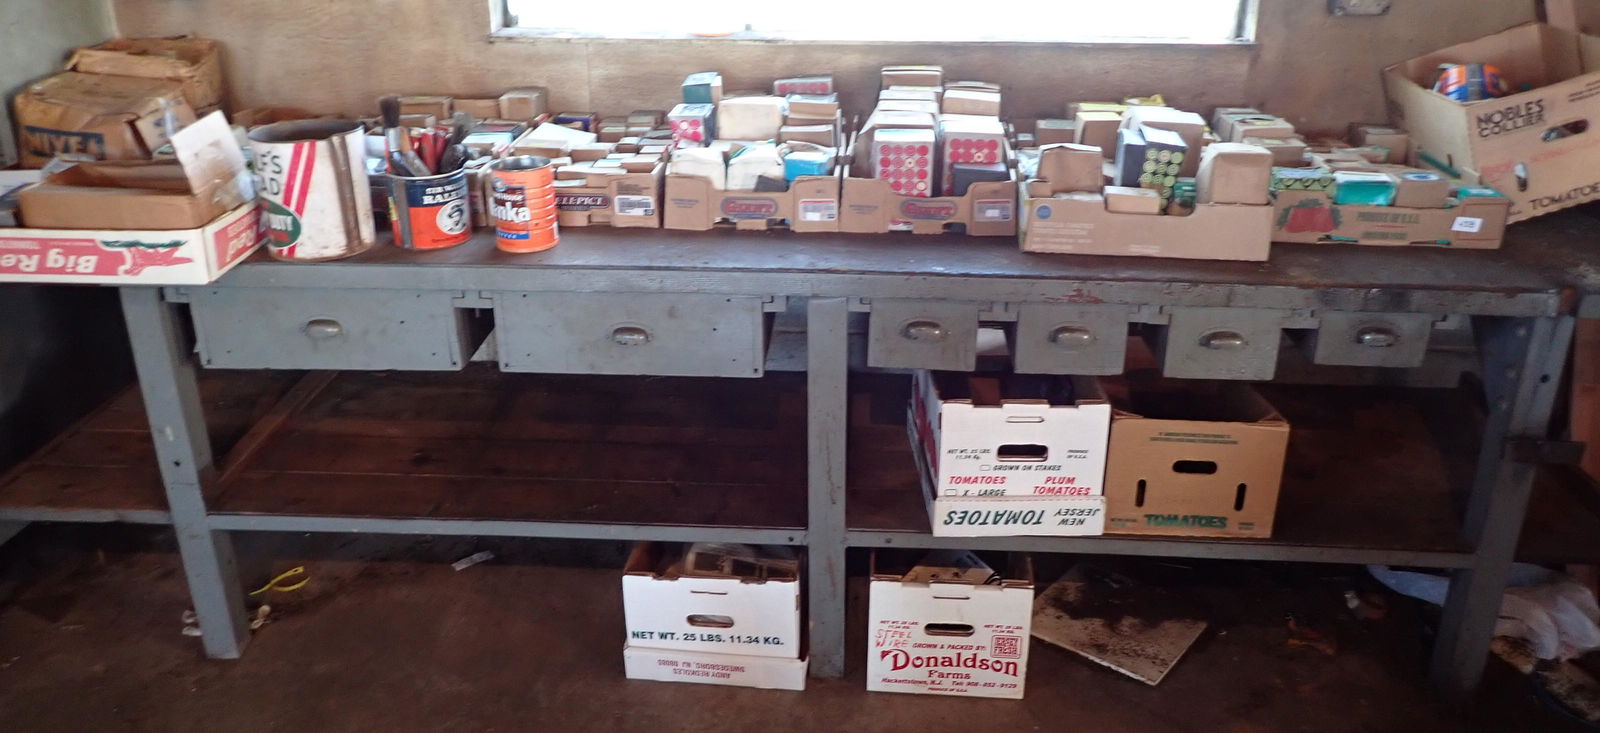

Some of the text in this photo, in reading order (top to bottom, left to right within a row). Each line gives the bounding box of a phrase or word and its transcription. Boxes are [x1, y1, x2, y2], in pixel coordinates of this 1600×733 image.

[1477, 99, 1544, 126] NOBLES
[1479, 113, 1545, 138] COLLIER
[46, 248, 99, 273] Big
[949, 476, 1007, 485] TOMATOES
[1044, 477, 1076, 485] PLUM
[1032, 486, 1092, 496] TOMATOES
[943, 509, 1046, 526] TOMATOES
[1054, 508, 1100, 517] JERSEY
[1057, 518, 1087, 526] NEW
[1144, 514, 1229, 529] TOMATOES
[631, 631, 785, 646] NET WT. 25 LBS. 11.34 KG.
[874, 629, 912, 639] STEEL
[880, 648, 1019, 677] Donaldson
[927, 670, 971, 680] Farms
